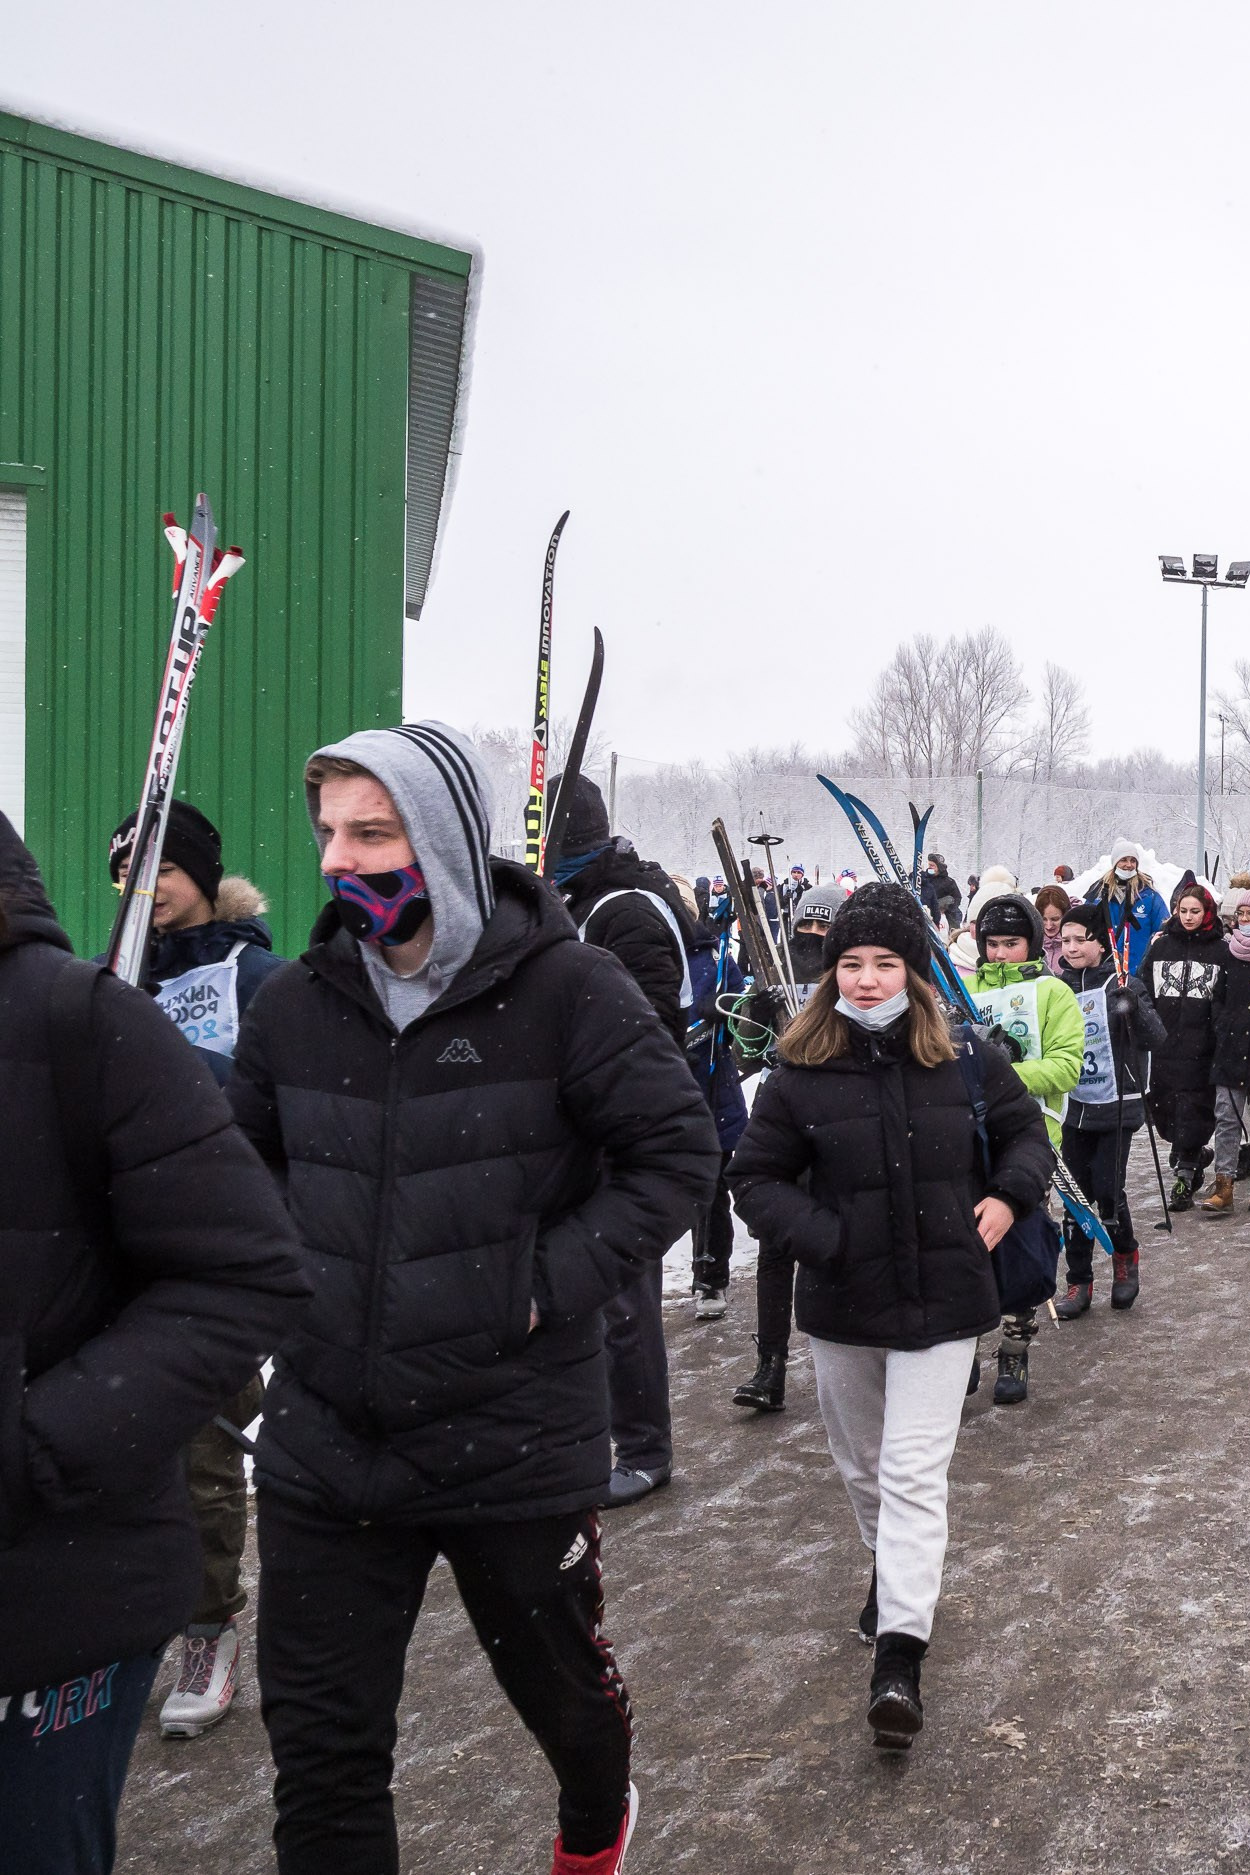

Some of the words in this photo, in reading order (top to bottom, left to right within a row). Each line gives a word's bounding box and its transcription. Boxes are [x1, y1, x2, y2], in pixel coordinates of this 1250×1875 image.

[541, 534, 560, 655] INNOVATION
[539, 659, 549, 720] SABLE
[535, 750, 544, 785] 195
[855, 821, 891, 884] PELTONEN
[806, 906, 829, 917] BLACK
